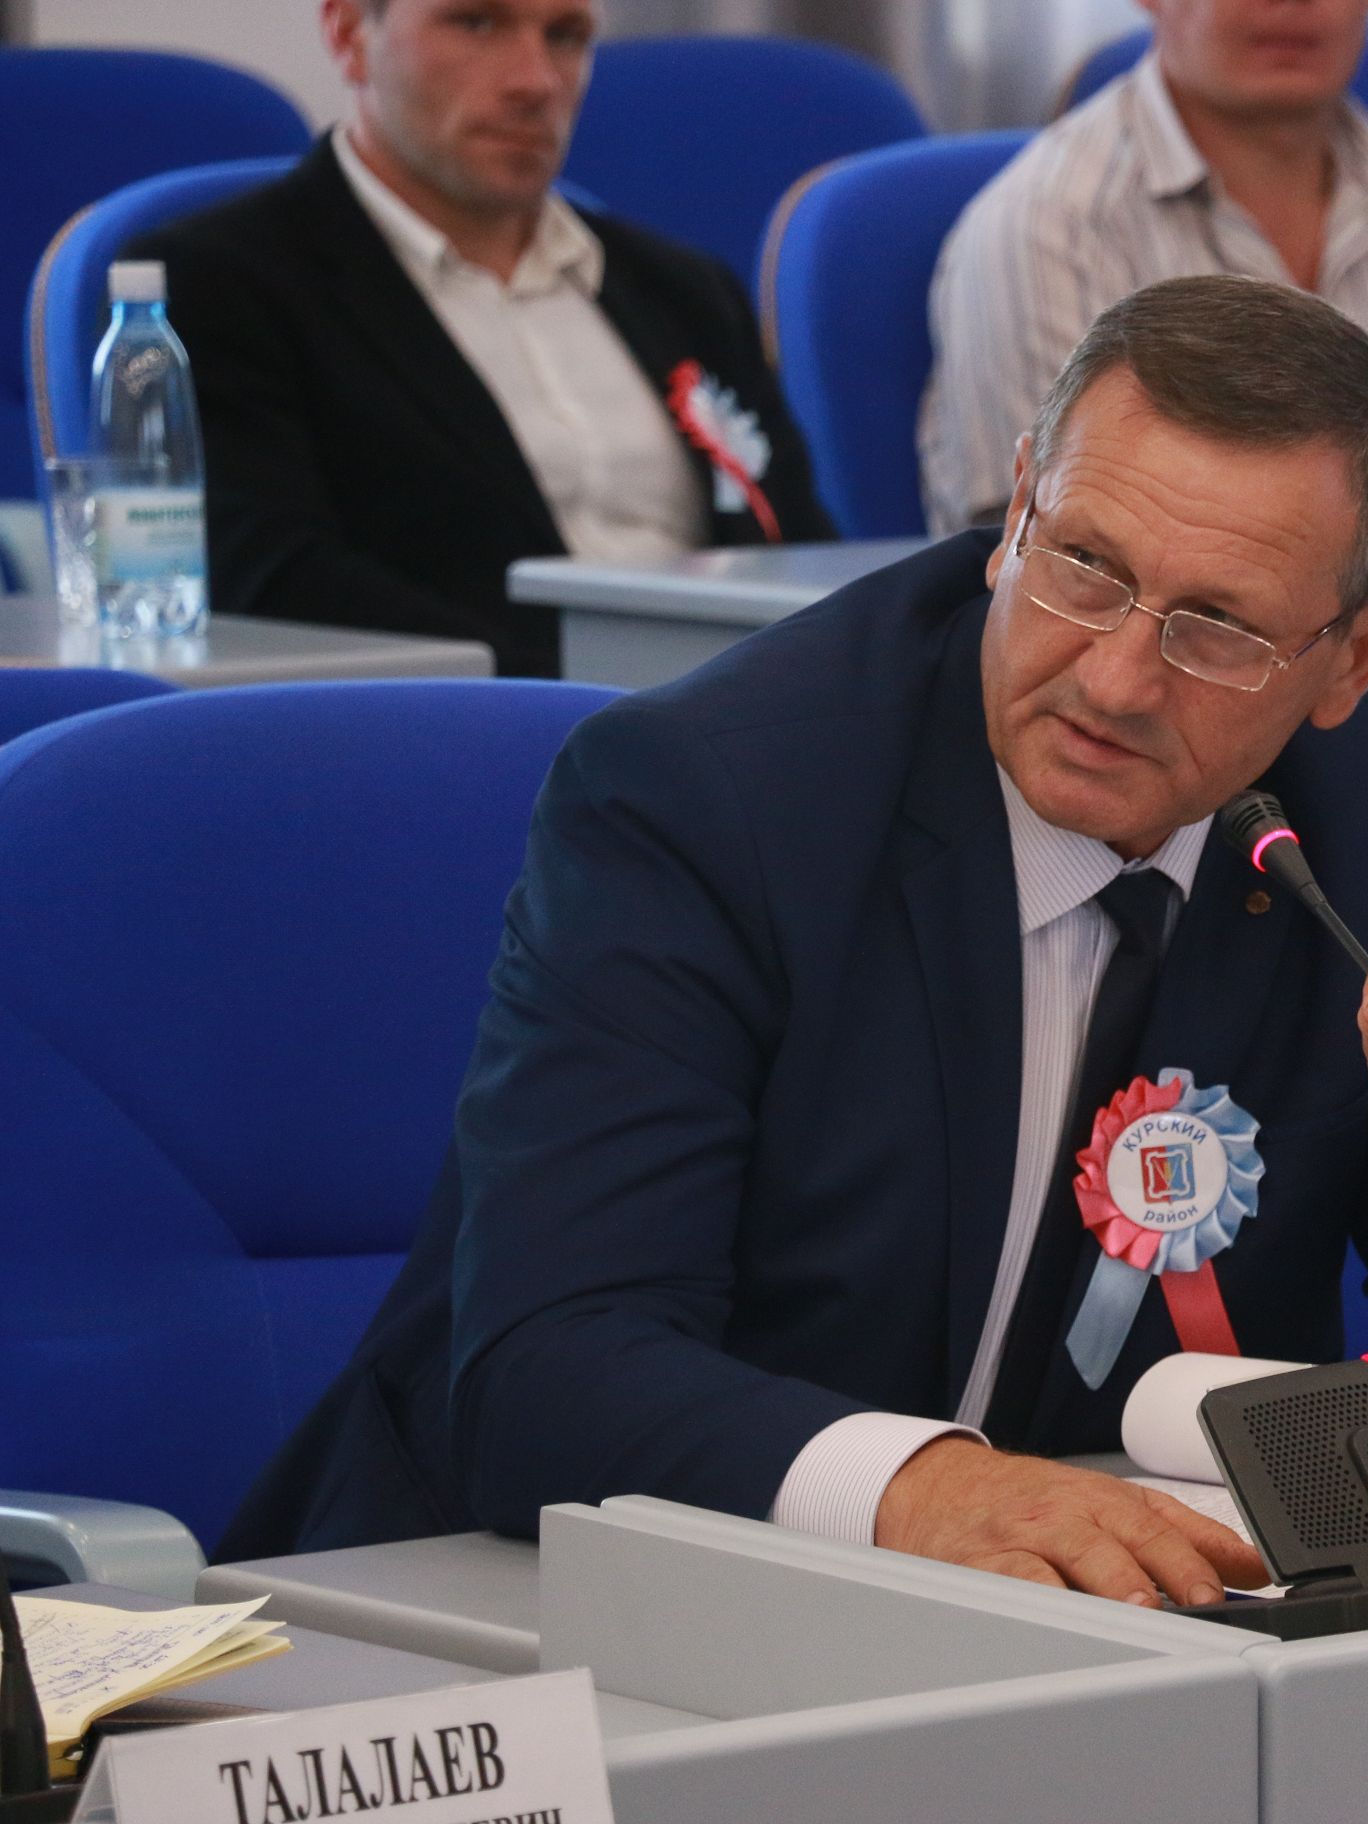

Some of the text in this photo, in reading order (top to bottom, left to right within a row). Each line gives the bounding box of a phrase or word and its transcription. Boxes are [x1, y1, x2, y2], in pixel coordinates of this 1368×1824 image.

[1122, 1118, 1207, 1152] КУРСКИЙ
[1144, 1205, 1198, 1223] район
[219, 1722, 505, 1824] ТАЛАЛАЕВ
